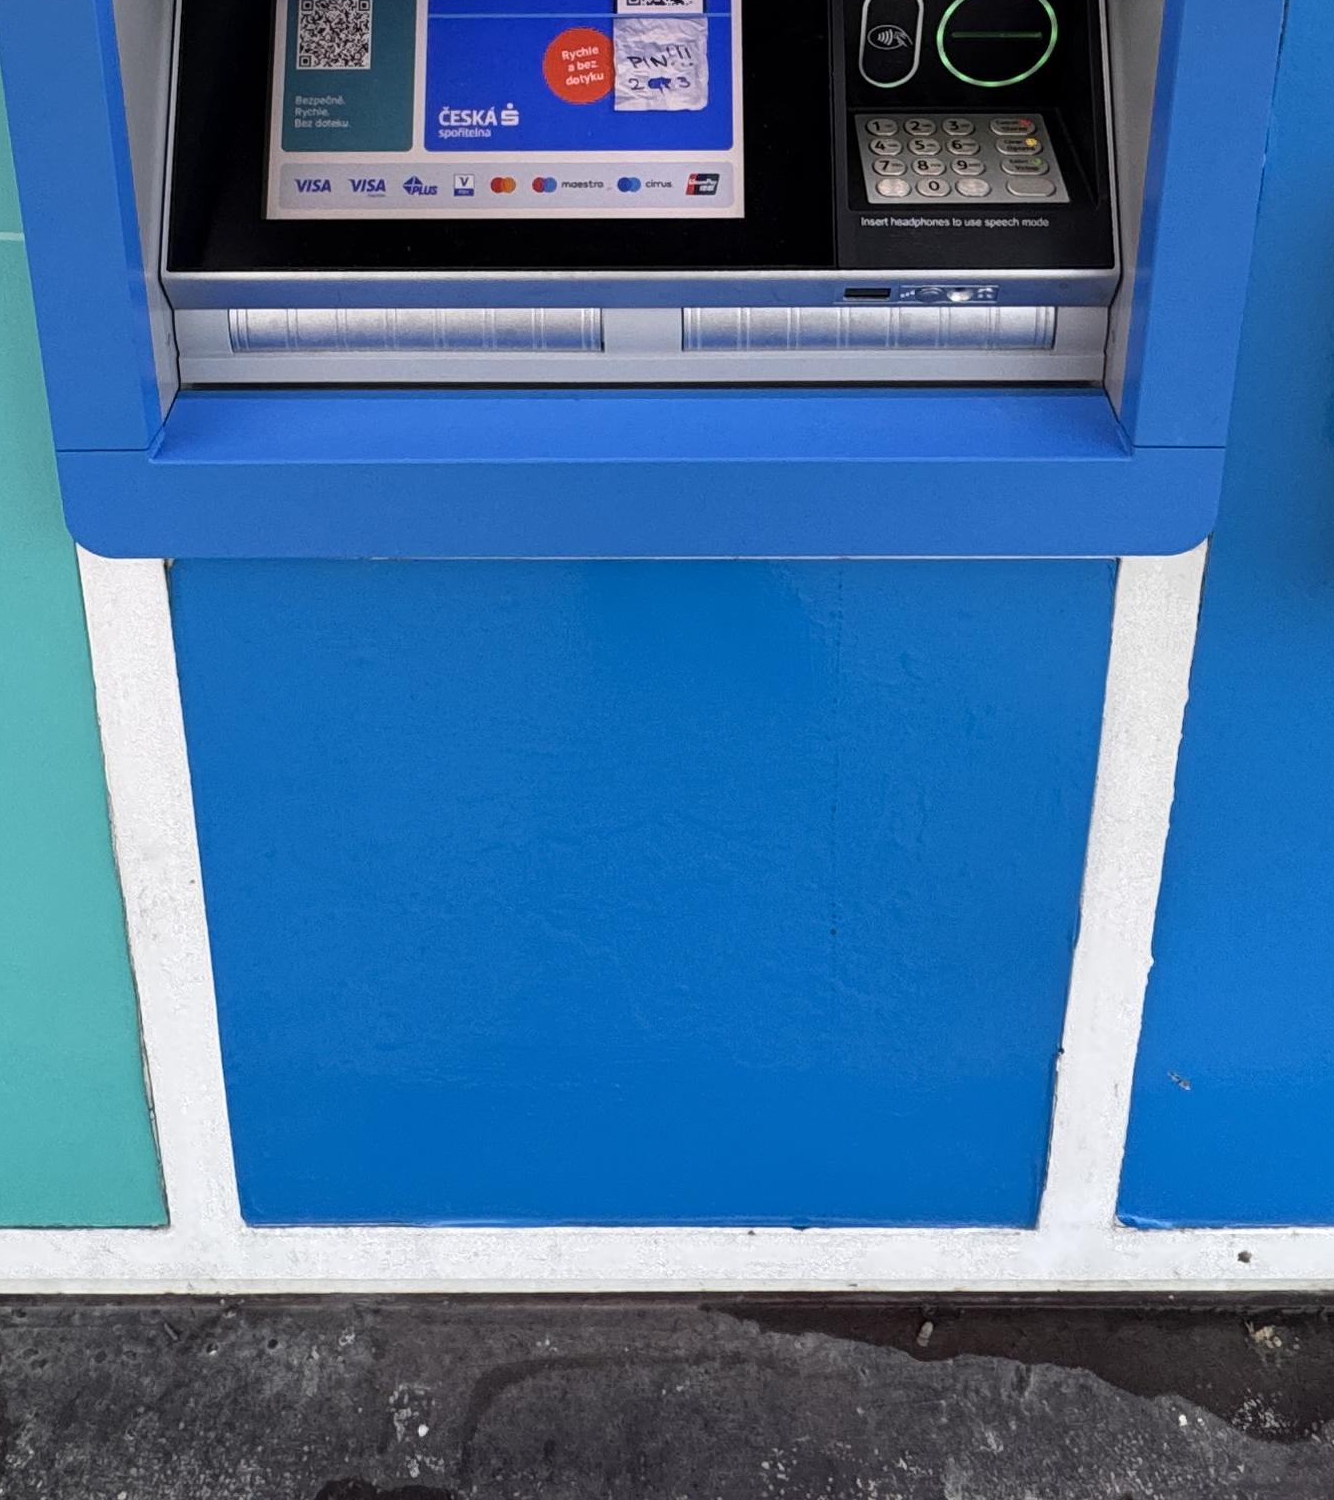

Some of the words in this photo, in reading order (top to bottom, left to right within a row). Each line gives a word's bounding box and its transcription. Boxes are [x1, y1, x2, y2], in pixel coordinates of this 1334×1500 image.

[561, 45, 600, 61] Rychle
[568, 64, 575, 73] a
[576, 60, 599, 72] bez
[565, 72, 605, 87] dotyku
[438, 106, 498, 127] ČESKÁ
[873, 121, 881, 132] 1
[909, 120, 920, 131] 2
[948, 120, 959, 131] 3
[438, 127, 492, 139] spořitelna
[874, 140, 886, 151] 4
[914, 140, 925, 150] 5
[952, 139, 963, 150] 6
[879, 160, 890, 171] 7
[917, 160, 929, 171] 8
[957, 160, 968, 170] 9
[294, 178, 333, 193] VISA
[348, 178, 387, 193] VISA
[411, 184, 439, 196] PLUS
[561, 180, 605, 189] maestro
[645, 180, 673, 189] cirrus
[928, 180, 940, 191] 0
[860, 216, 888, 227] Insert
[890, 216, 950, 229] headphones
[952, 217, 962, 227] to
[964, 219, 982, 227] use
[984, 216, 1019, 229] speech
[1021, 217, 1050, 227] mode
